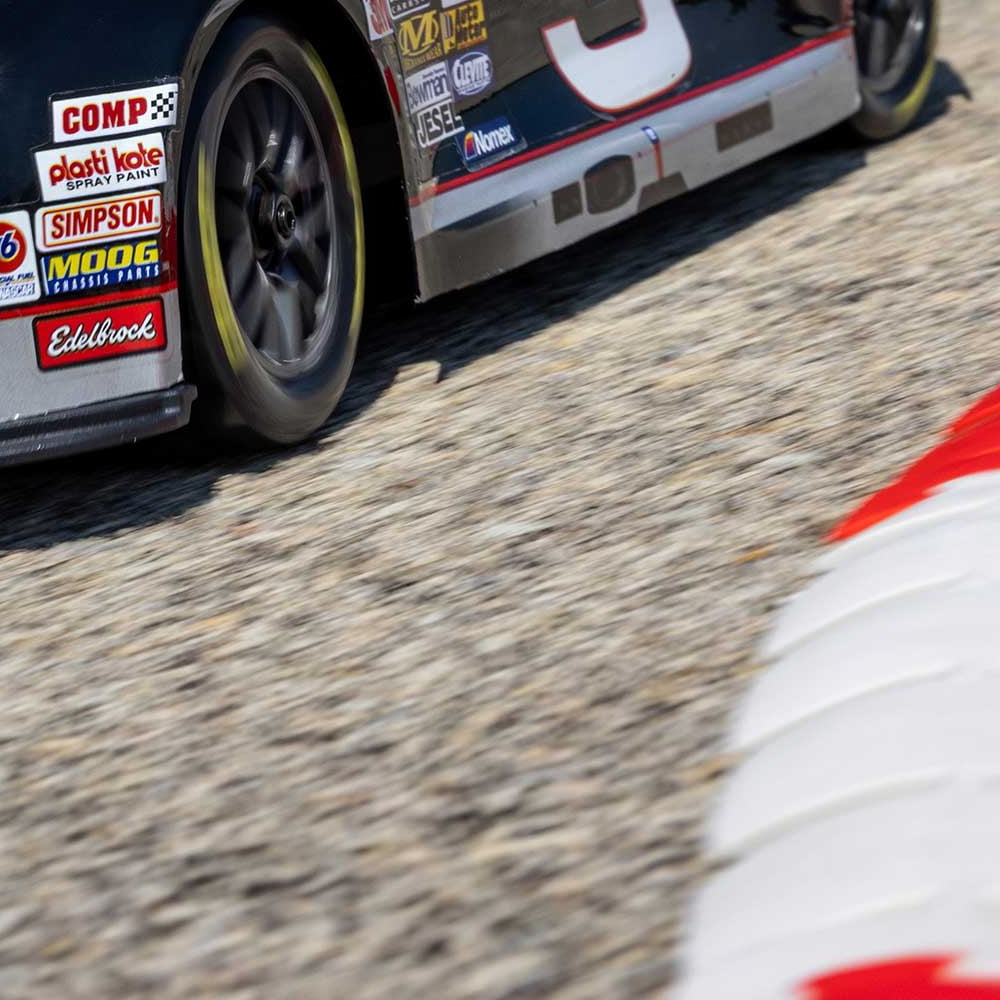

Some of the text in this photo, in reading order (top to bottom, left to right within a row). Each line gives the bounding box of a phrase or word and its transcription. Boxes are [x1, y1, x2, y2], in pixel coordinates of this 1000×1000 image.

[62, 96, 148, 135] COMP
[418, 101, 463, 147] JESEL
[474, 125, 514, 155] Nomex
[49, 142, 164, 187] plasti kote
[66, 167, 159, 191] SPRAY PAINT
[51, 199, 154, 239] SIMPSON
[48, 240, 159, 281] MOOG
[54, 264, 159, 294] CHASSIS PARTS
[47, 312, 156, 357] Edelbrock
